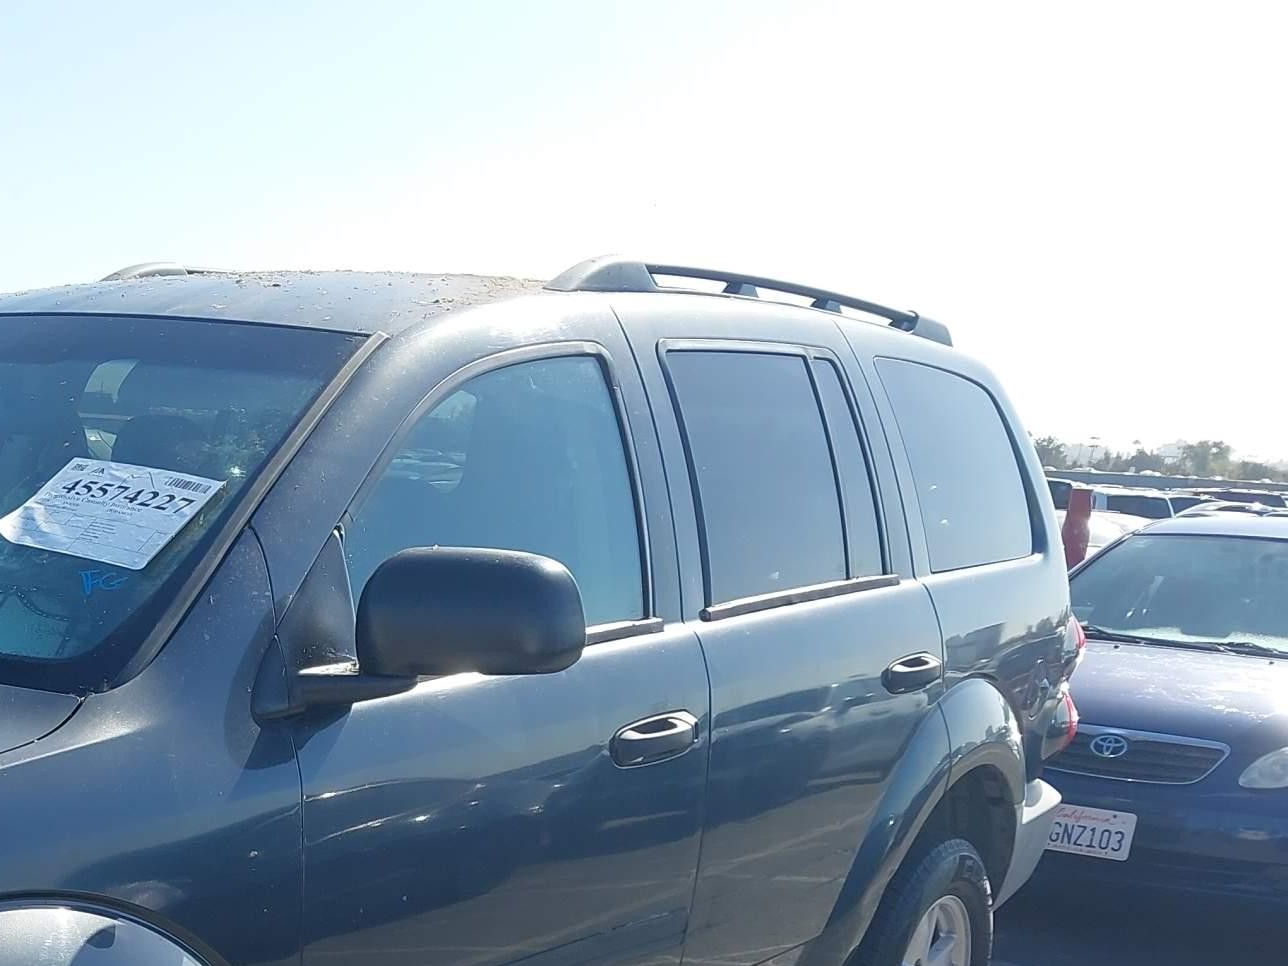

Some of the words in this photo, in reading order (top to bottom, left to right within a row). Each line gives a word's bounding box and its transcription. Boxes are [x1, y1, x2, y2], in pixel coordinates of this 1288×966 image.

[62, 479, 197, 515] 45574227
[1056, 807, 1115, 826] California
[1049, 822, 1125, 852] GNZ103
